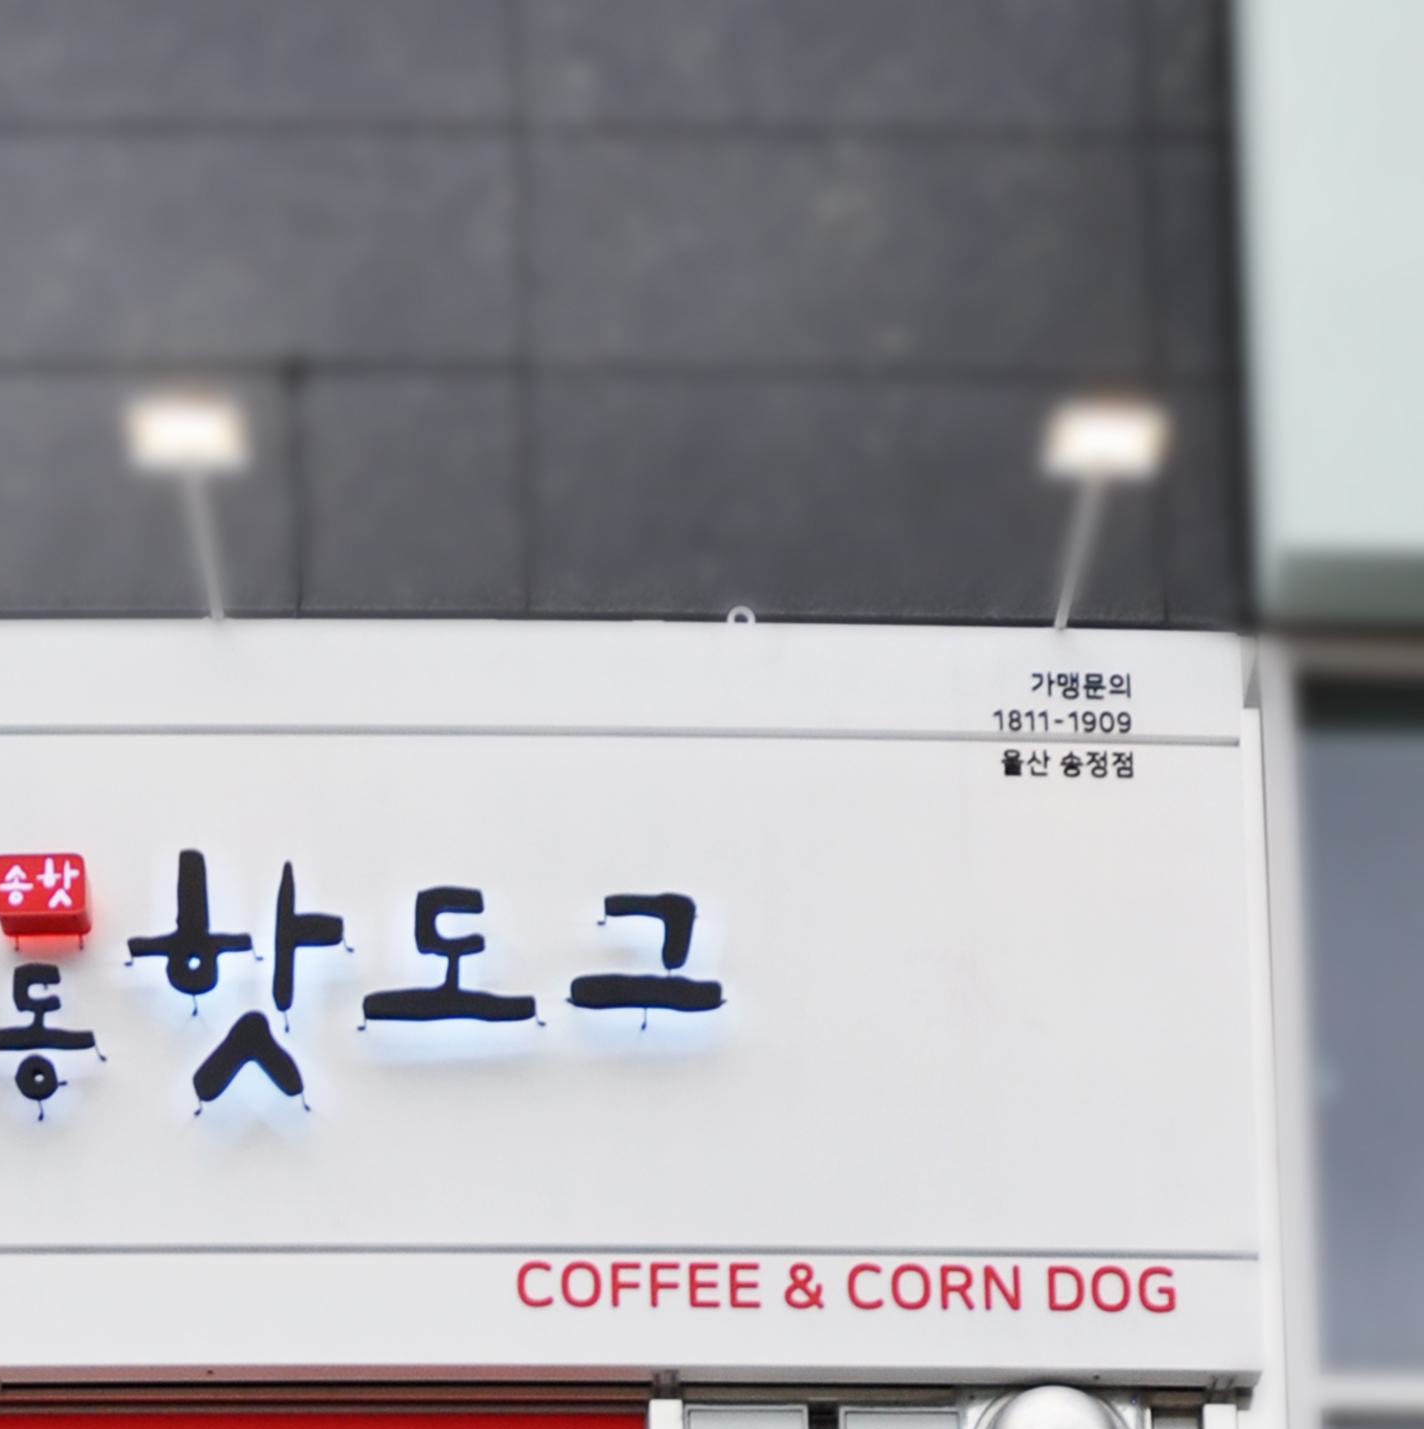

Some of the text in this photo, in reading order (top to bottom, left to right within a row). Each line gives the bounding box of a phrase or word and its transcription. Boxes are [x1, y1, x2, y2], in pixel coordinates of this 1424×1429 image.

[1031, 672, 1131, 700] 가맹문의
[993, 709, 1132, 733] 1811-1909
[1001, 749, 1134, 778] 울산 송정점
[127, 848, 724, 1103] 핫도그
[516, 1261, 1176, 1313] COFFEE & CORN DOG
